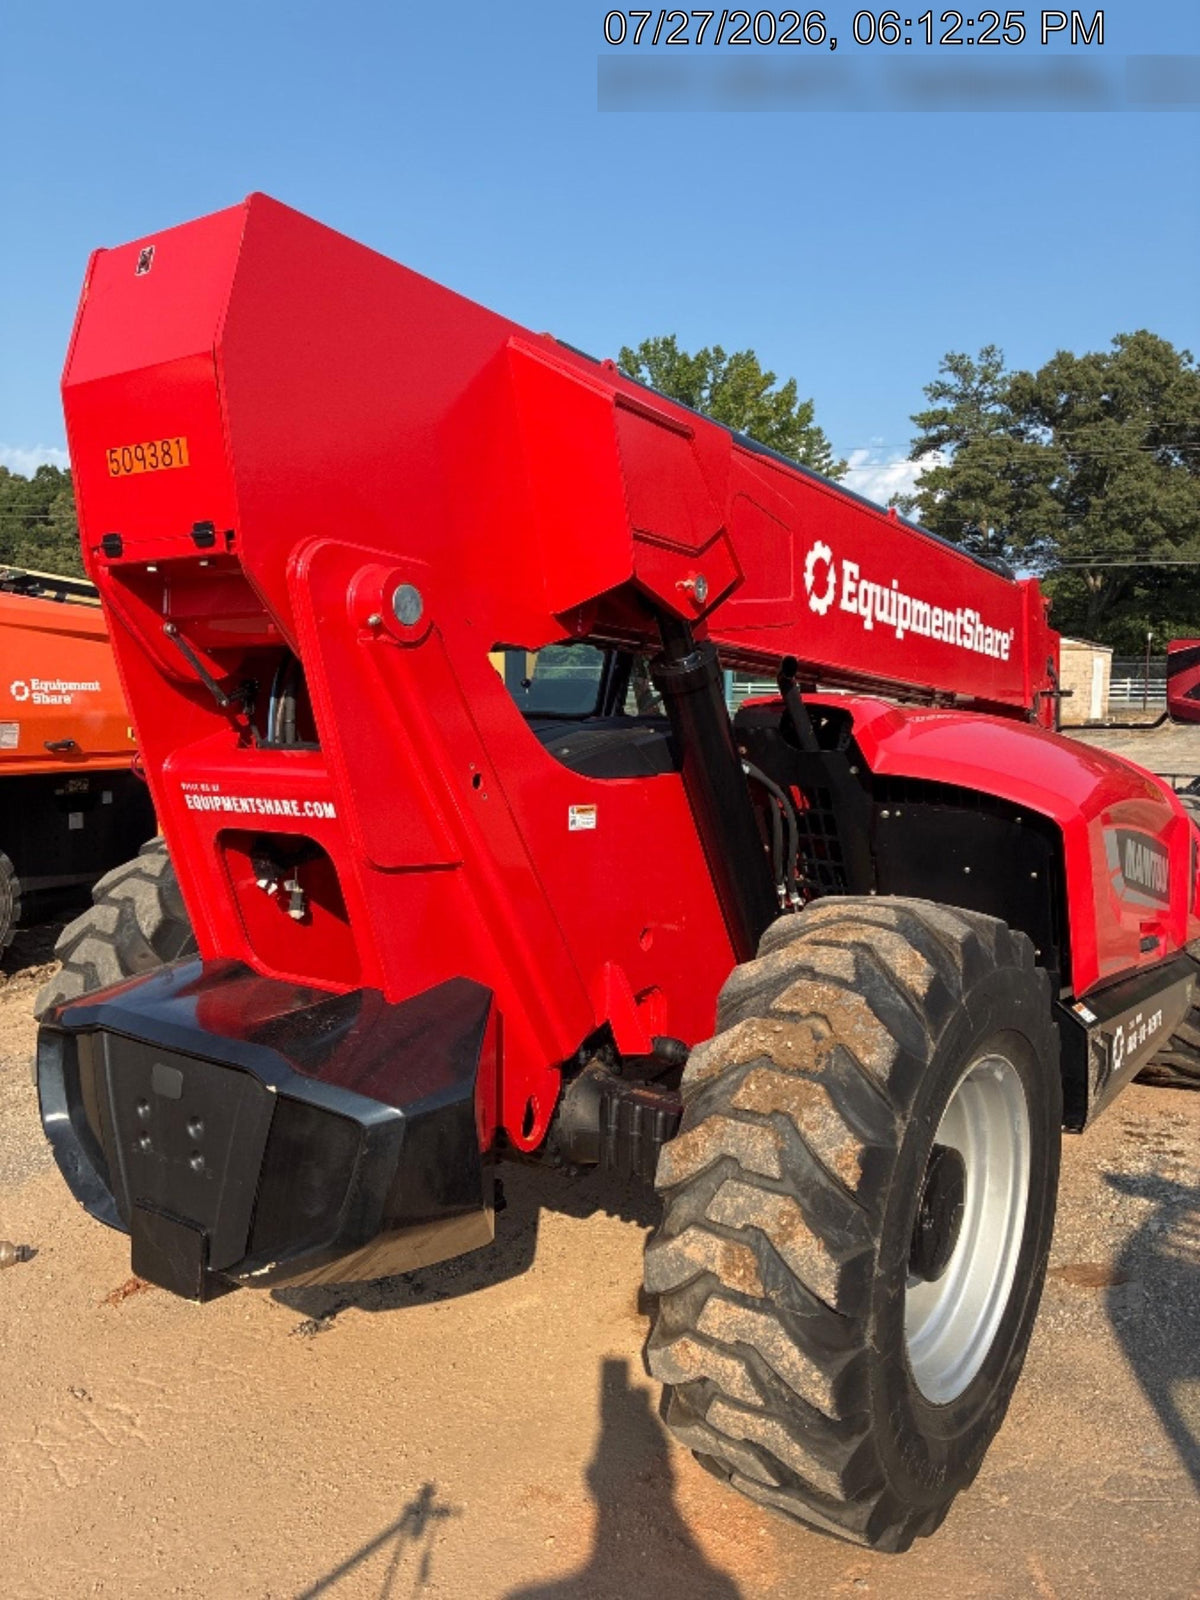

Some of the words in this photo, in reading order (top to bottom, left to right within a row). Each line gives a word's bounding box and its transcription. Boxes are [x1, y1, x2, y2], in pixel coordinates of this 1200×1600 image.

[109, 438, 184, 475] 509381
[839, 559, 1011, 661] EquipmentShare
[30, 678, 101, 693] Equipment
[31, 693, 72, 704] Share
[184, 794, 337, 819] EQUIPMENTSHARE.COM
